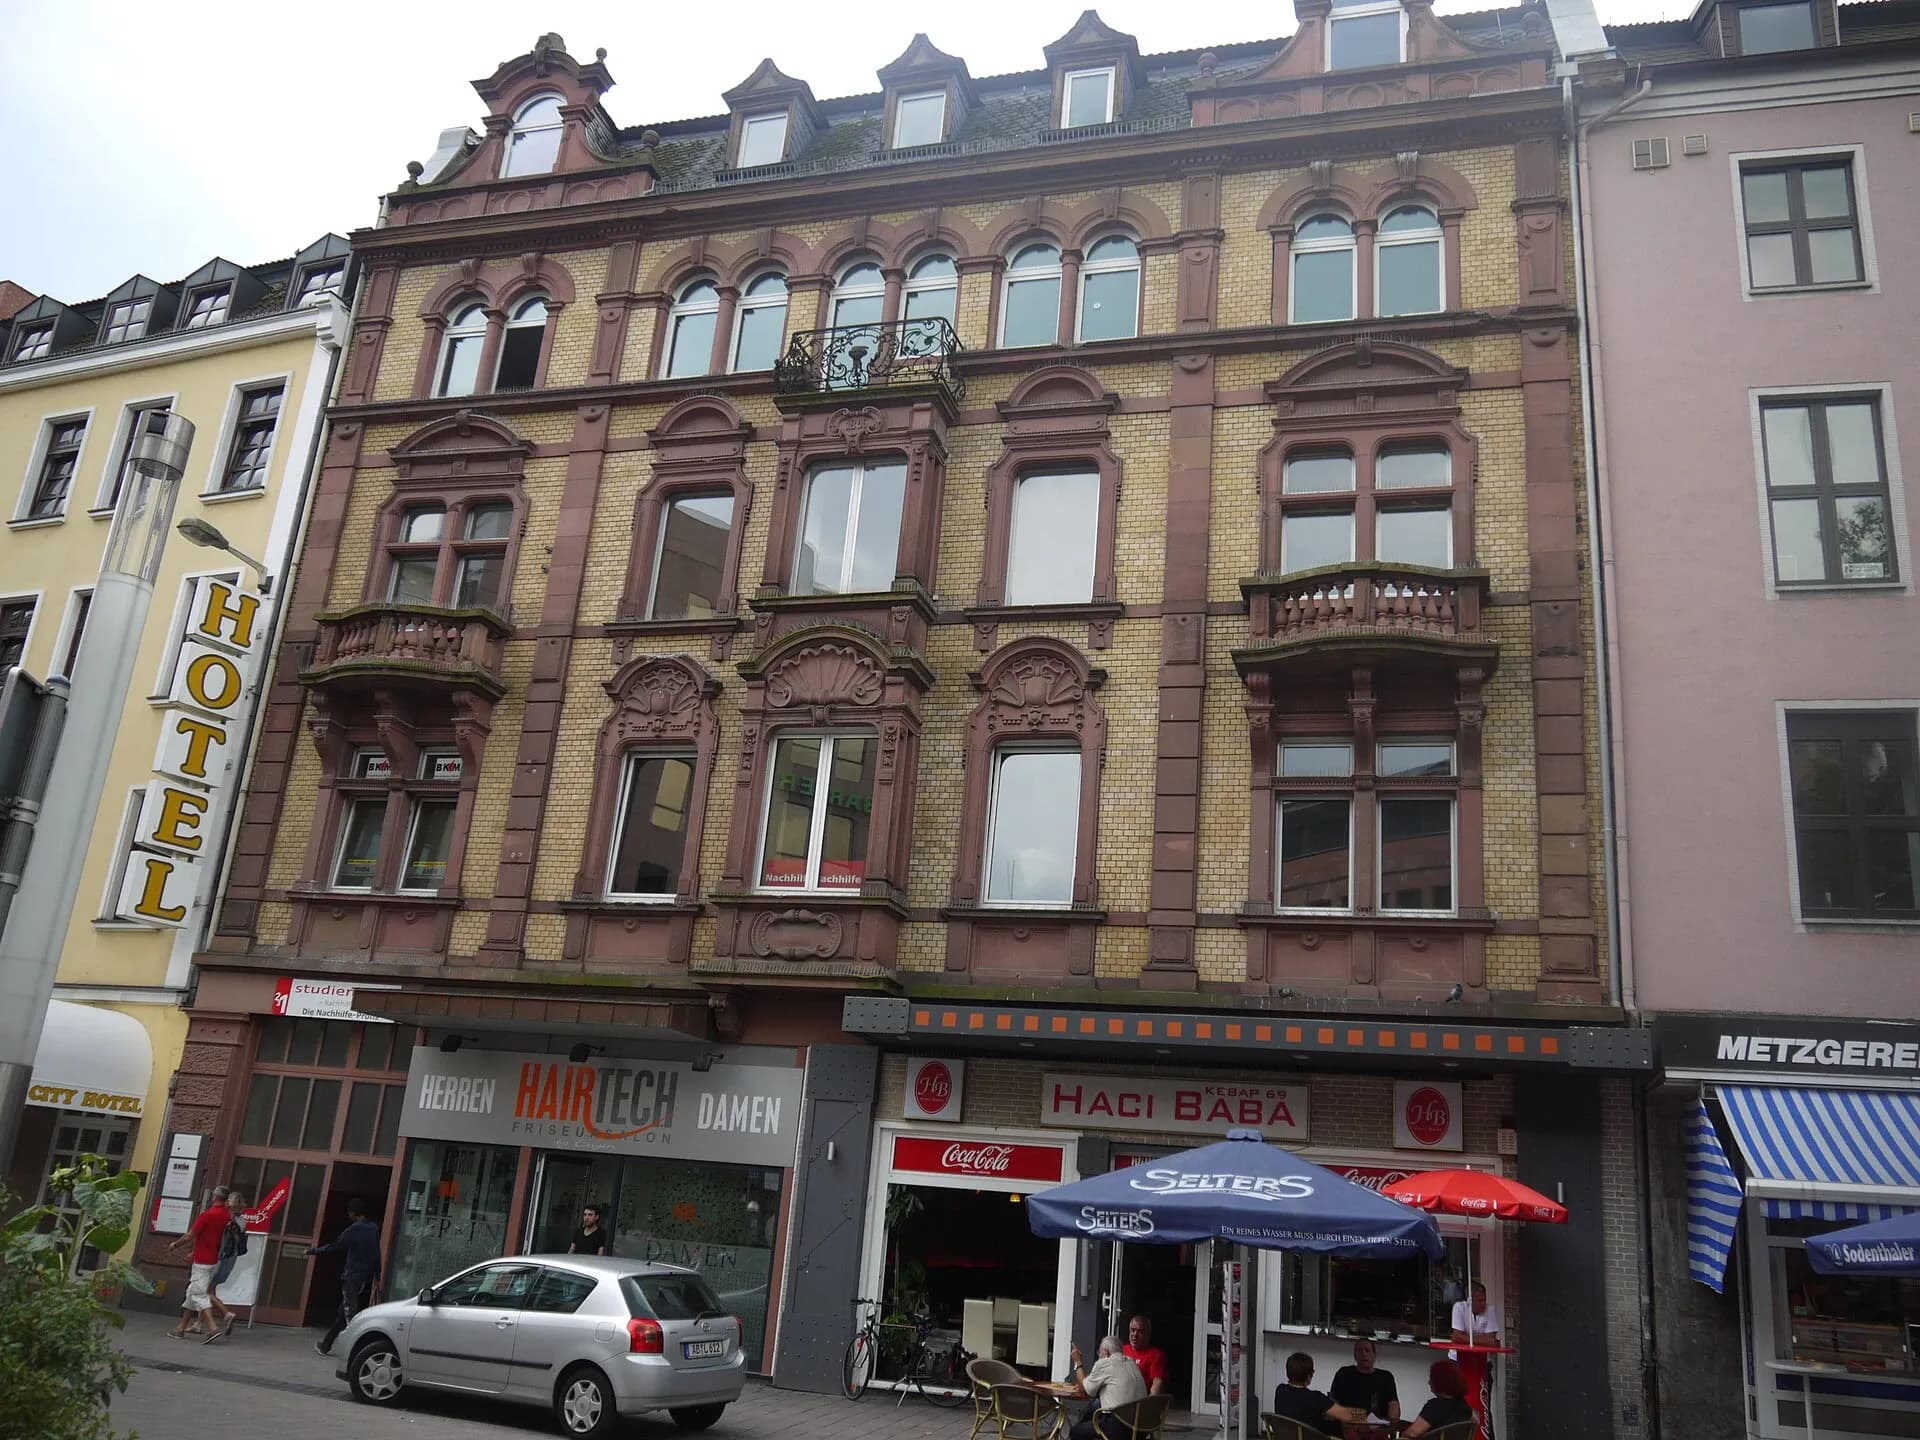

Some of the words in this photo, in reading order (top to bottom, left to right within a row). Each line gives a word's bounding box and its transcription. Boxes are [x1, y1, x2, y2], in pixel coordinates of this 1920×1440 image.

[135, 582, 260, 922] HOTEL
[765, 874, 806, 882] Nachhil
[821, 875, 862, 884] achhilfe
[302, 1008, 315, 1016] Die
[1717, 1035, 1920, 1068] METZGERE
[28, 1085, 78, 1105] CITY
[80, 1091, 142, 1114] HOTEL
[418, 1074, 496, 1114] HERREN
[1053, 1083, 1154, 1120] HACI
[1174, 1090, 1296, 1127] BABA
[1205, 1086, 1260, 1098] KEBAP
[1266, 1090, 1287, 1099] 69
[698, 1092, 782, 1135] DAMEN
[942, 1143, 1014, 1171] Coca-Cola
[1129, 1169, 1315, 1201] SELTERS
[1344, 1169, 1417, 1197] Coca-C
[1076, 1205, 1154, 1236] SELTERS
[1221, 1226, 1234, 1235] EIN
[1236, 1227, 1261, 1237] REINES
[1262, 1228, 1292, 1239] WASSER
[1316, 1233, 1341, 1242] DURCH
[646, 1239, 738, 1269] DAMEN
[1842, 1242, 1915, 1263] Sodenthaler
